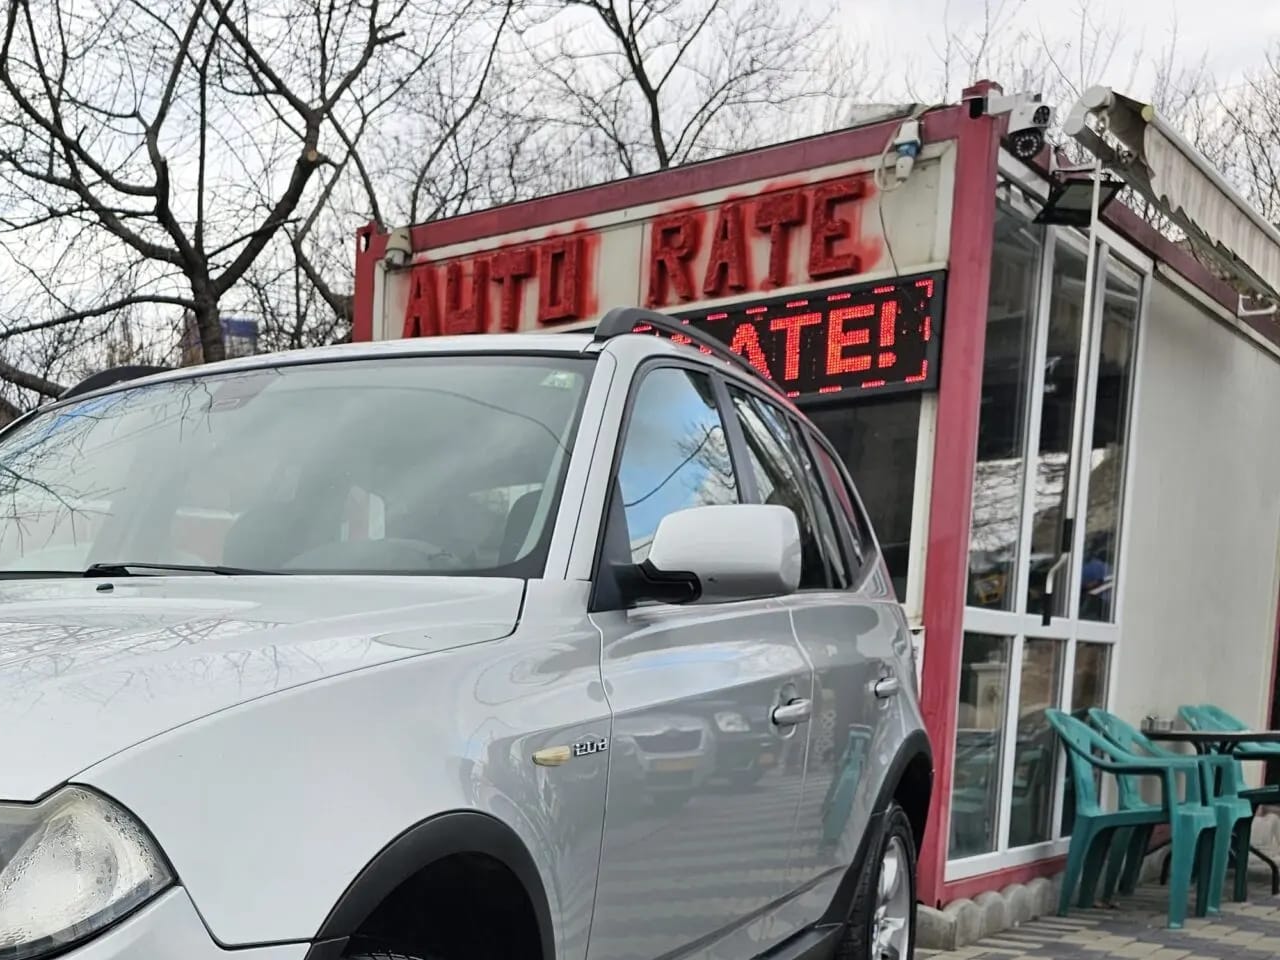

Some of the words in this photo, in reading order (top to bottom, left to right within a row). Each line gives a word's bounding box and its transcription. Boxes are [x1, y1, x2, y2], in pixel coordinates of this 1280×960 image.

[403, 235, 586, 338] AUTO
[646, 175, 866, 307] RATE
[723, 299, 897, 381] ATE!
